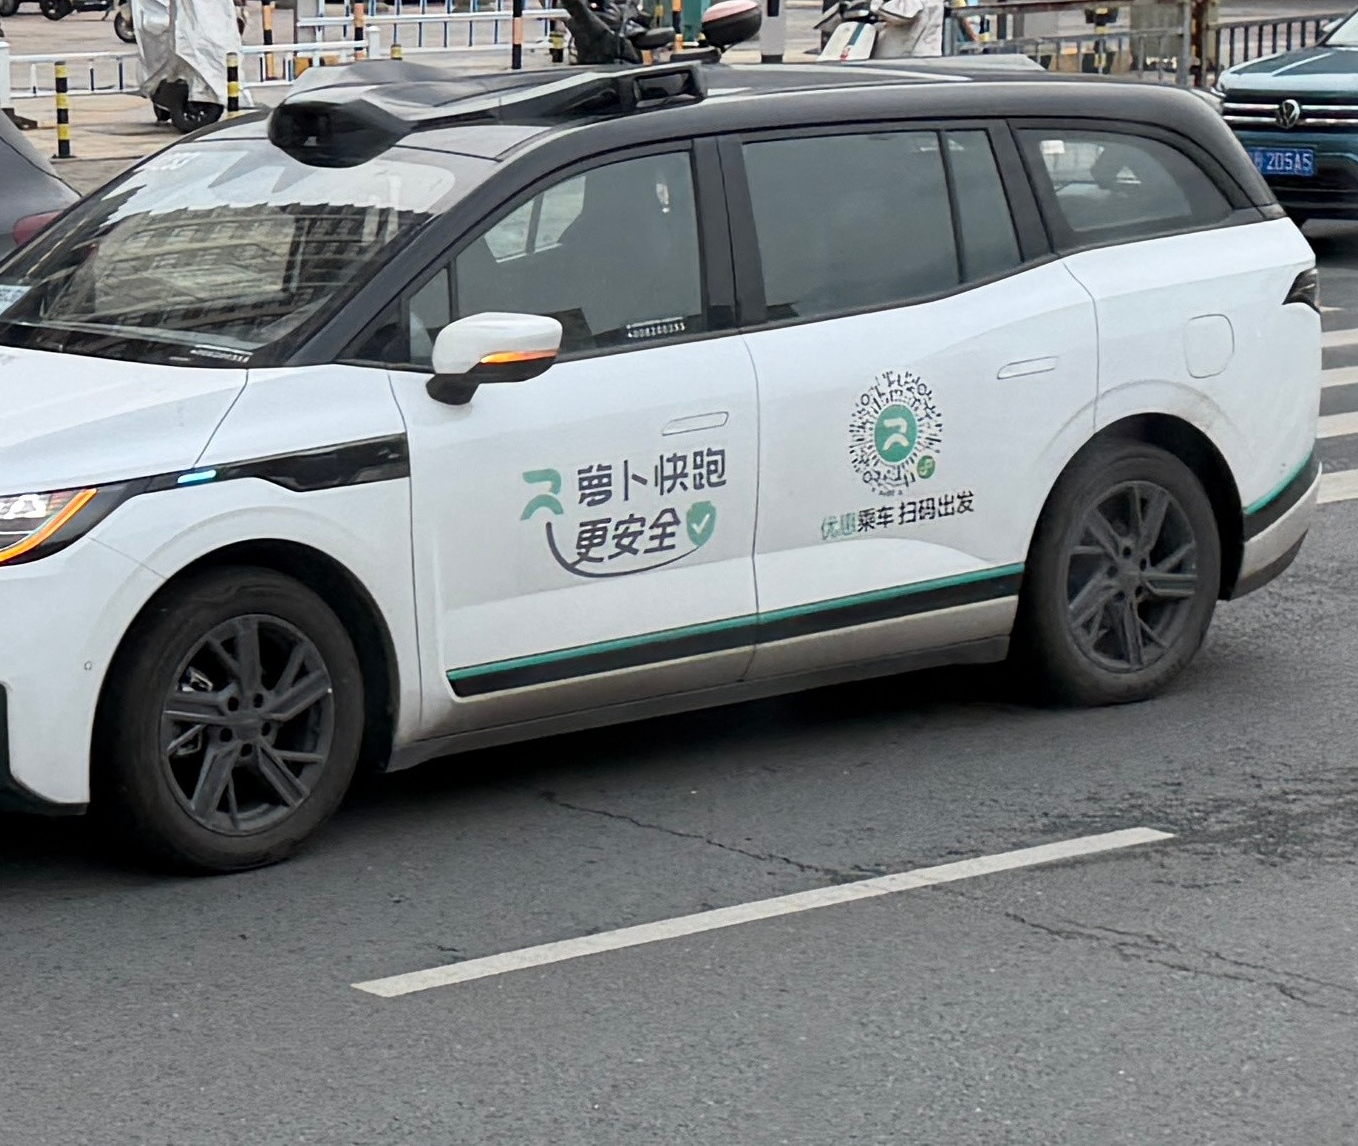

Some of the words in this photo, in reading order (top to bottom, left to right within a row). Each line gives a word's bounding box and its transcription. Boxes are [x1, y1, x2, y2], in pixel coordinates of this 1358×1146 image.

[577, 447, 727, 507] 萝卜快跑
[574, 507, 682, 567] 更安全
[898, 490, 975, 526] 扫码出发
